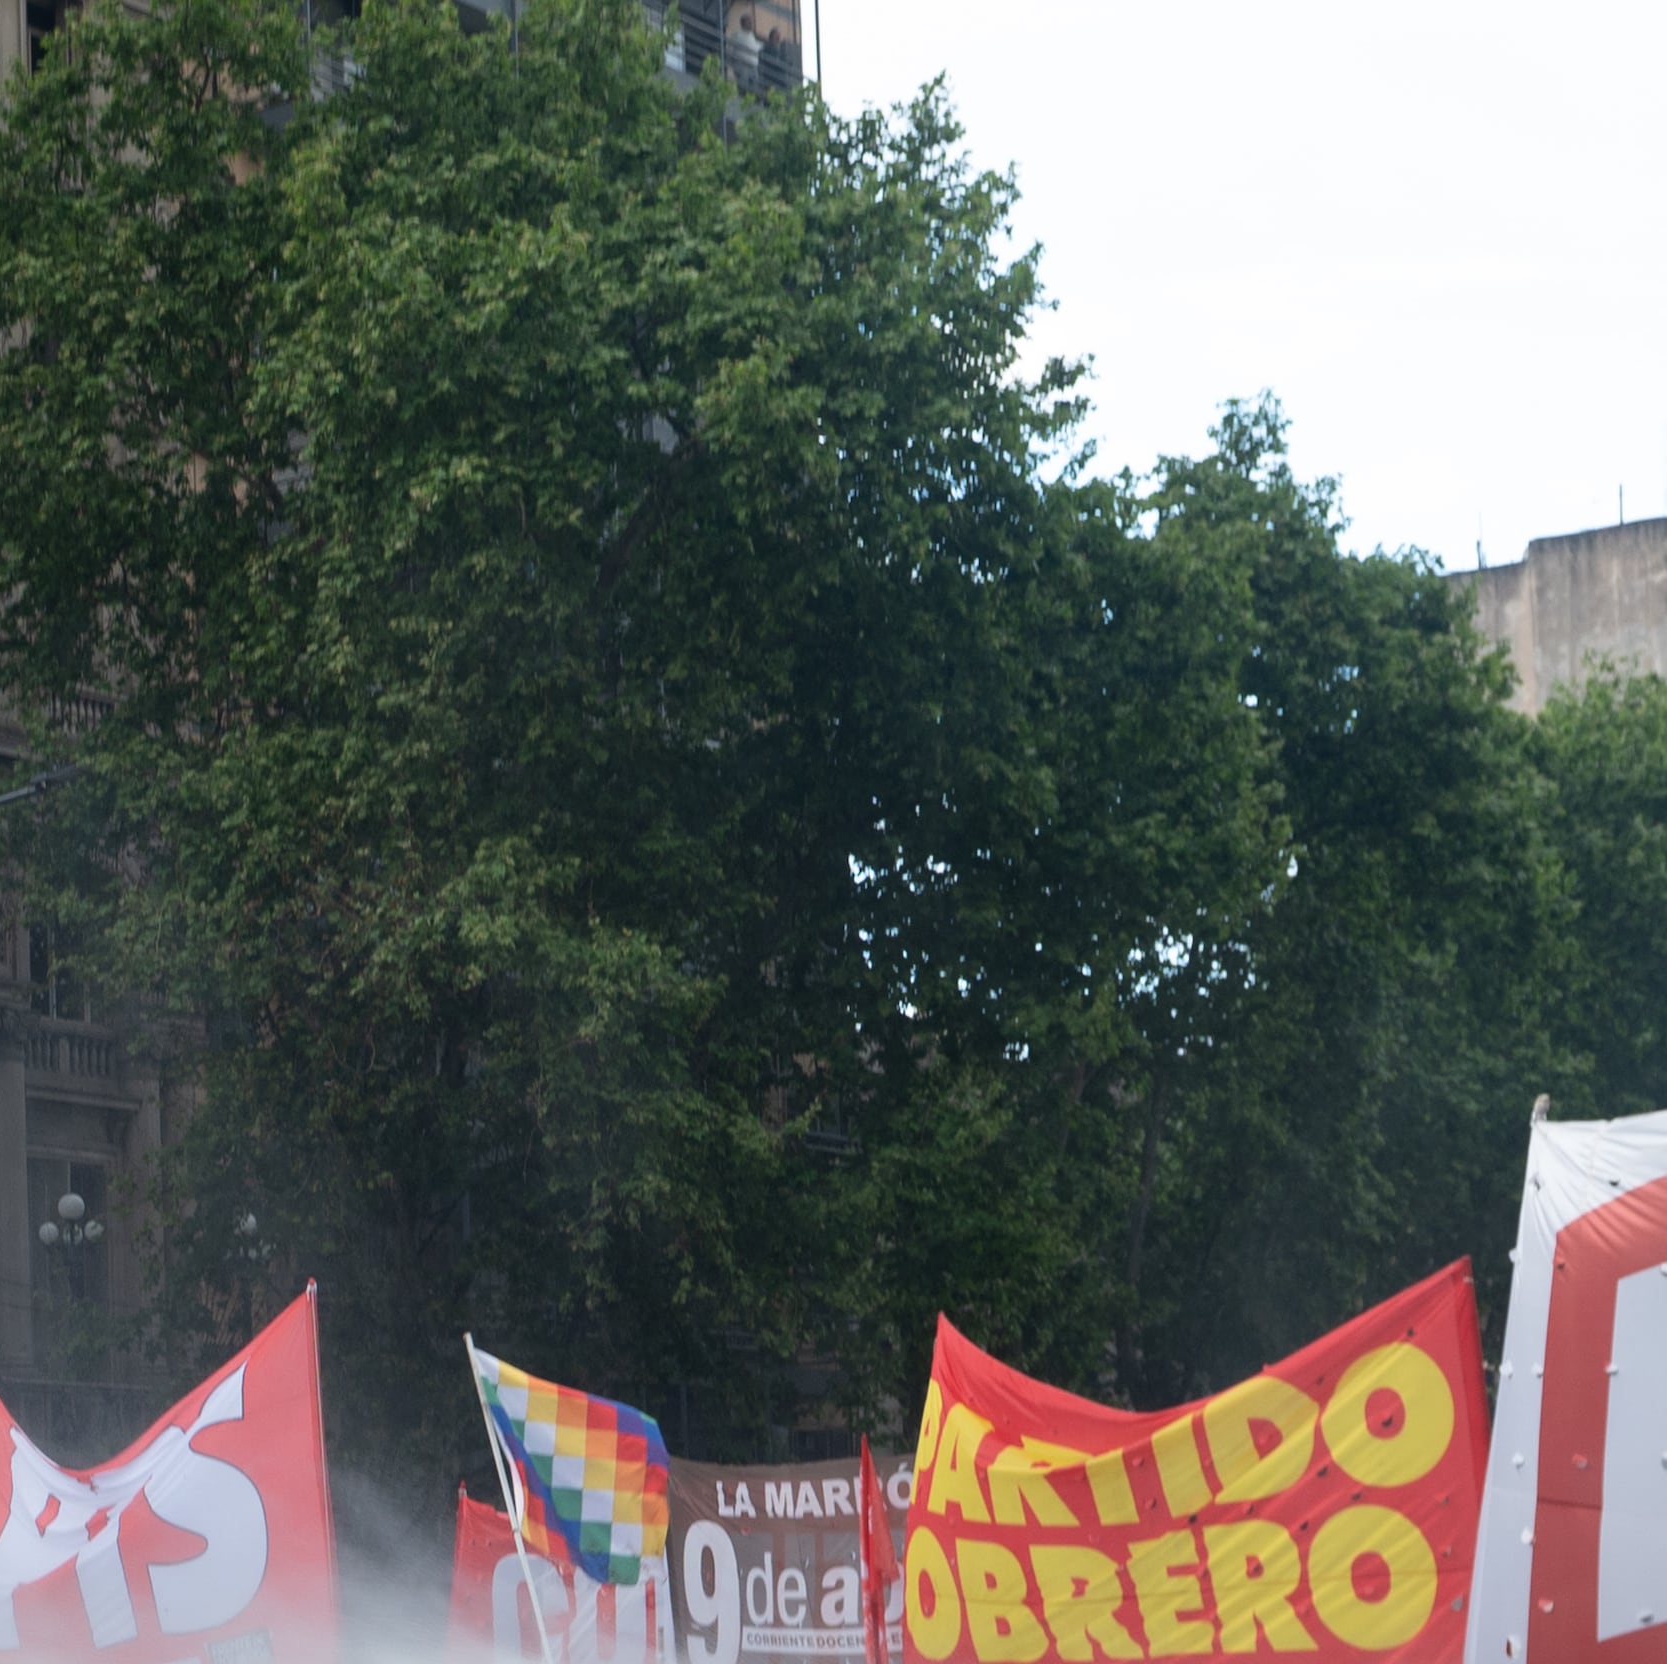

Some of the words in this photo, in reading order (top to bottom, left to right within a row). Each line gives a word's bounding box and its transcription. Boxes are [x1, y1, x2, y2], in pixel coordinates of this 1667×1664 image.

[910, 1341, 1455, 1526] PARTIDO
[715, 1479, 757, 1519] LA
[746, 1551, 808, 1626] de
[904, 1504, 1439, 1664] OBRERO
